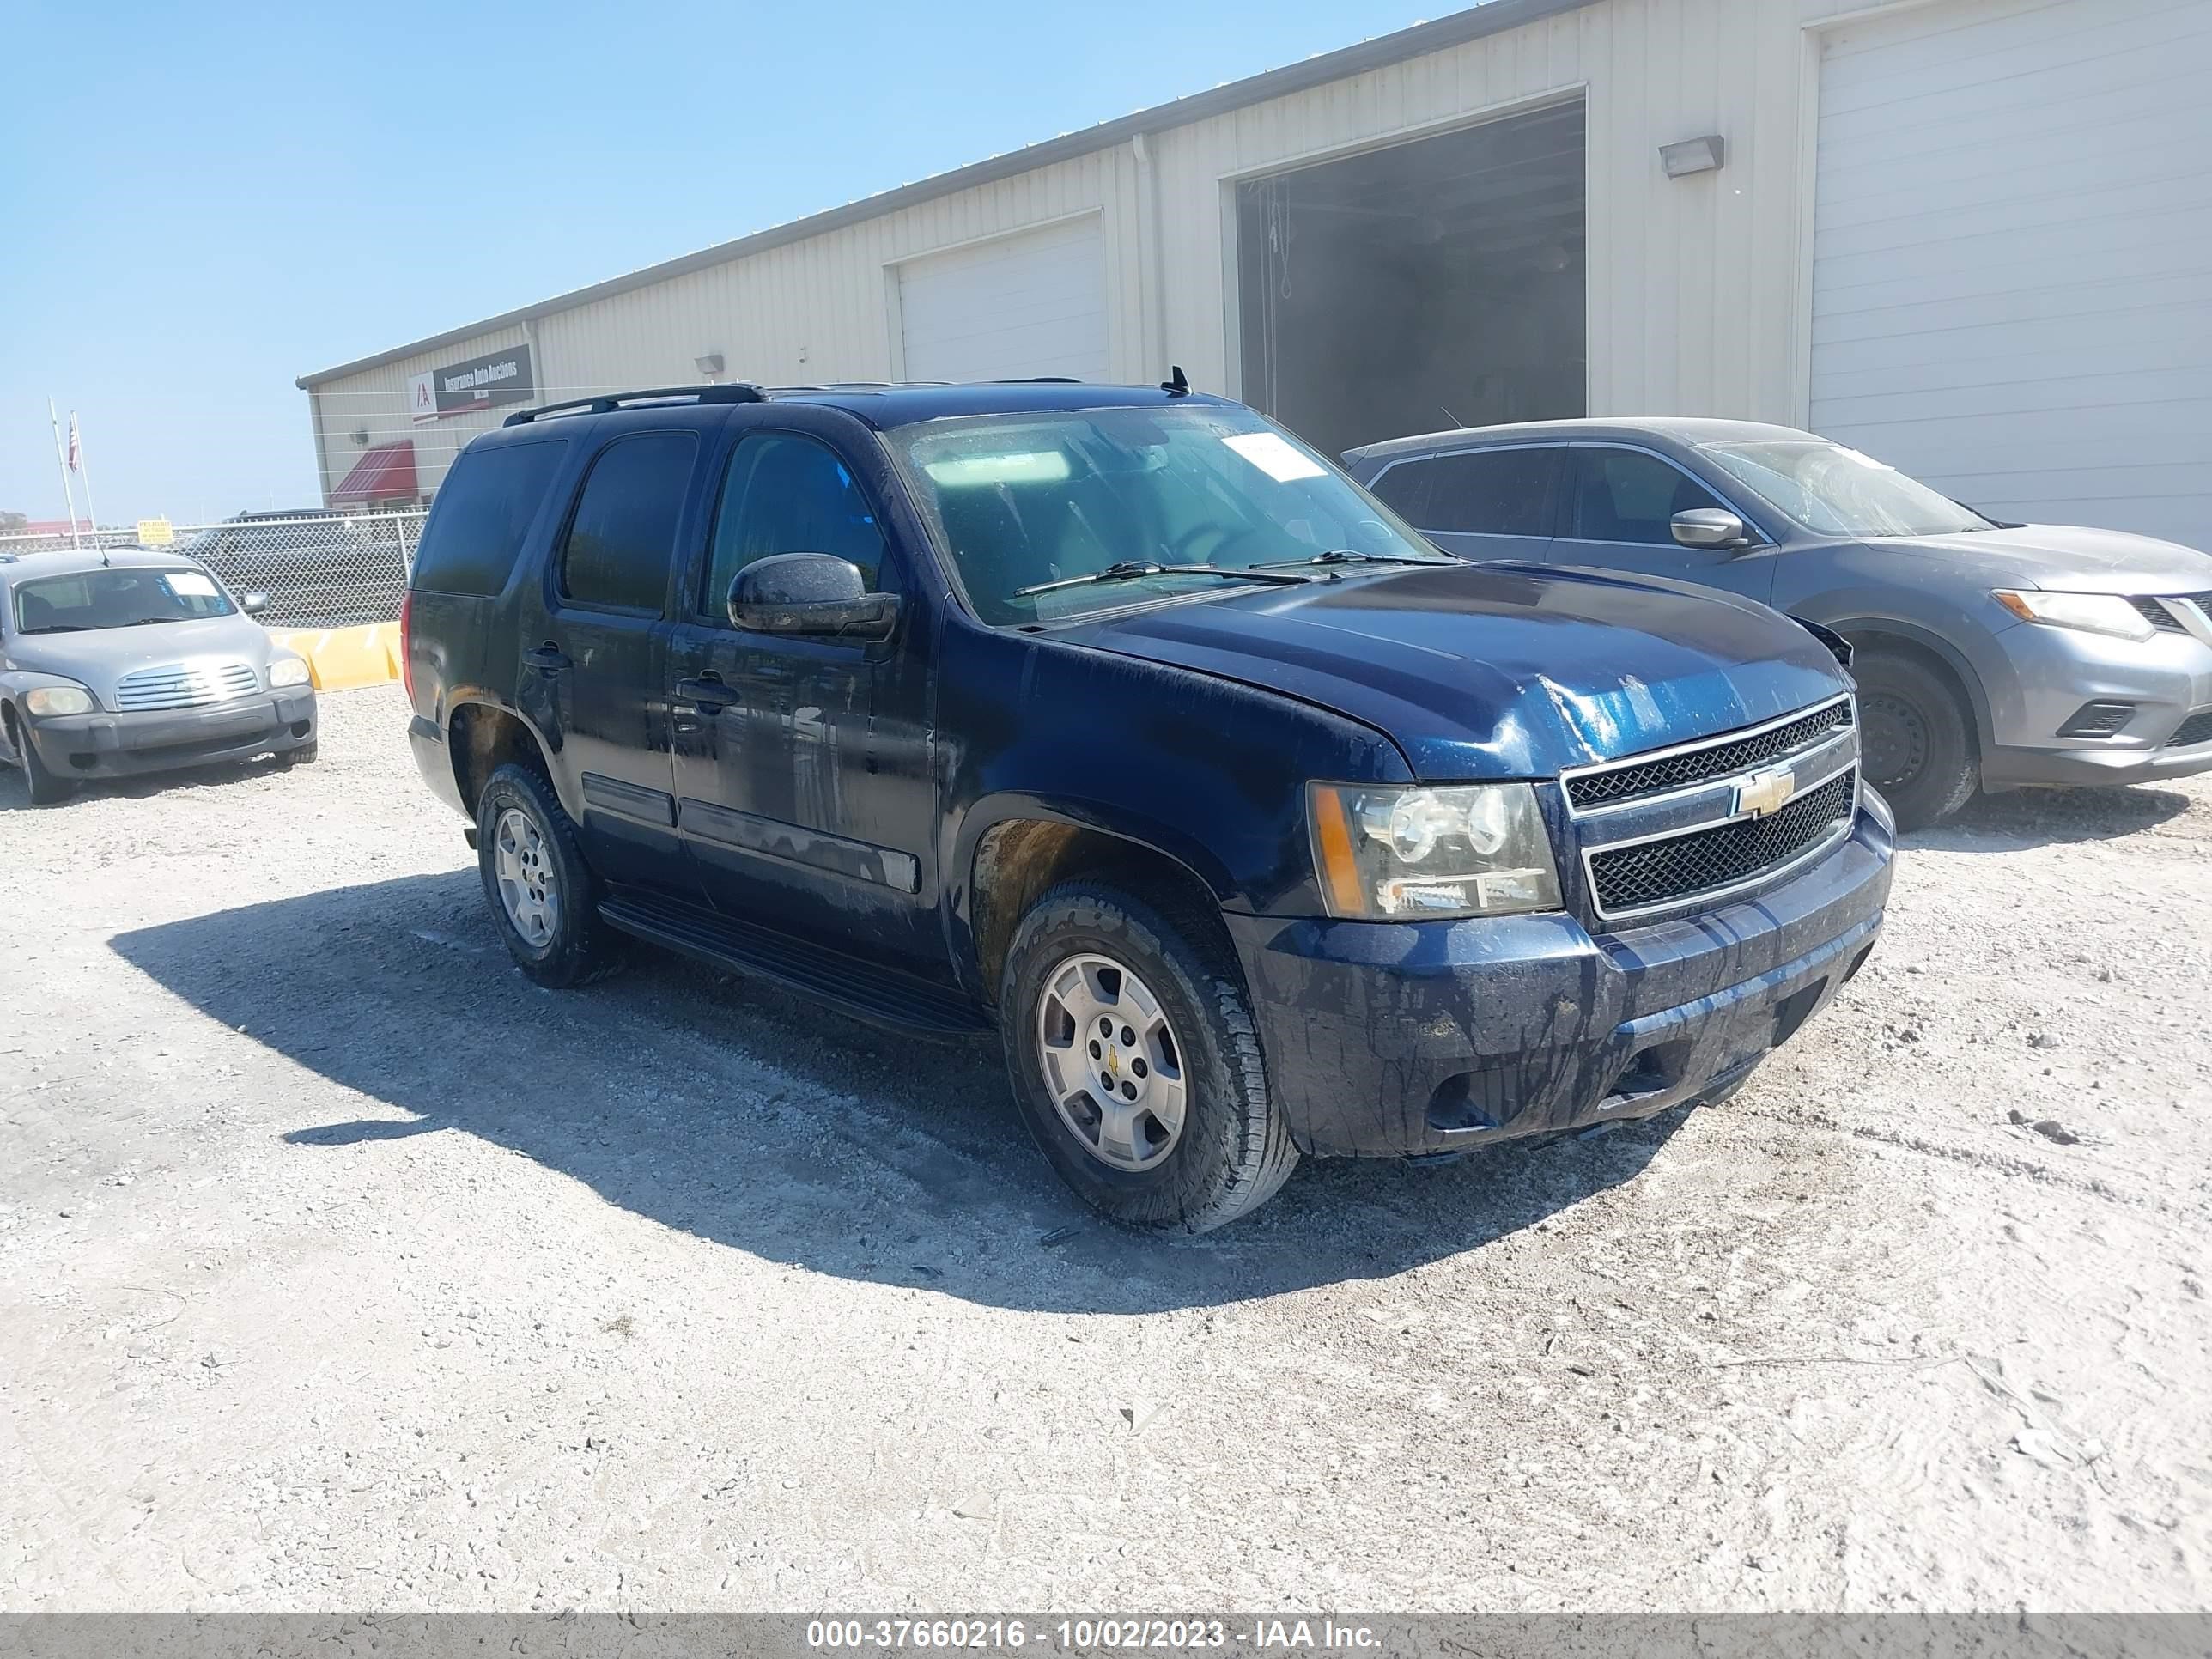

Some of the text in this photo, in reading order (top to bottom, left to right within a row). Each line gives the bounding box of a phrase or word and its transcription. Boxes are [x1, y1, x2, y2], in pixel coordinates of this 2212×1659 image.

[444, 361, 518, 393] Insurance Auto Auctions
